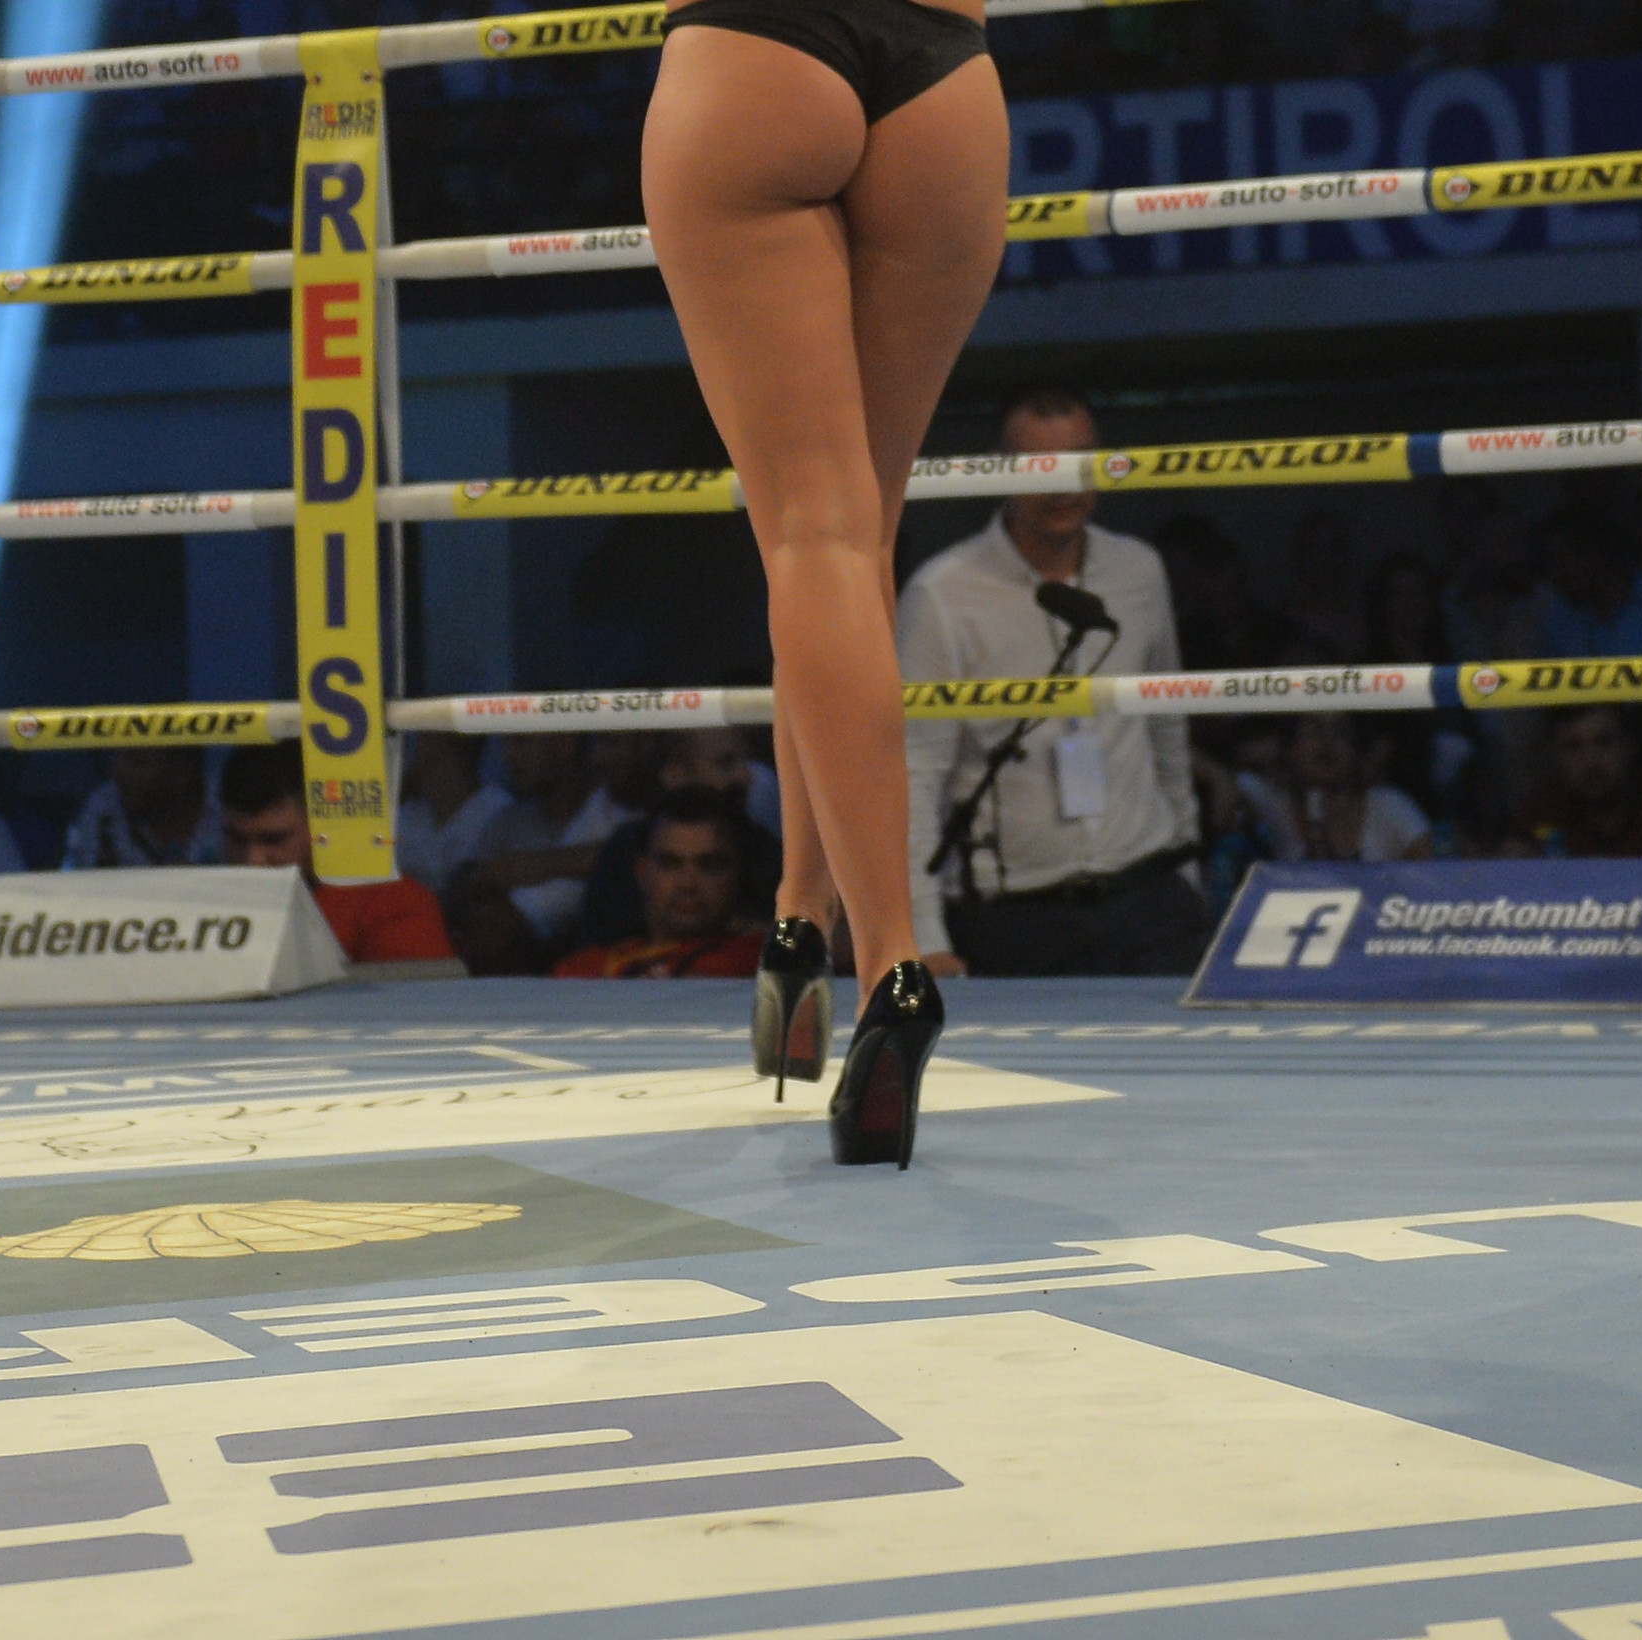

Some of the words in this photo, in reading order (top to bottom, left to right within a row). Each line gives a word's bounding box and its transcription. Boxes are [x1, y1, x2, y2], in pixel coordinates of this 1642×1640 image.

[24, 50, 242, 89] www.auto-soft.ro
[304, 99, 377, 127] REDIS
[1135, 171, 1399, 214] www.auto-soft.ro
[39, 258, 243, 292] DUNLOP
[302, 162, 369, 756] REDIS
[1150, 437, 1394, 476] DUNLOP
[488, 467, 721, 500] DUNLOP
[16, 490, 233, 519] www.auto-soft.ro
[1138, 667, 1406, 701] www.auto-soft.ro
[464, 688, 702, 717] www.auto-soft.ro
[57, 709, 255, 741] DUNLOP
[310, 778, 383, 805] REDIS
[1376, 894, 1642, 934] Superkombat
